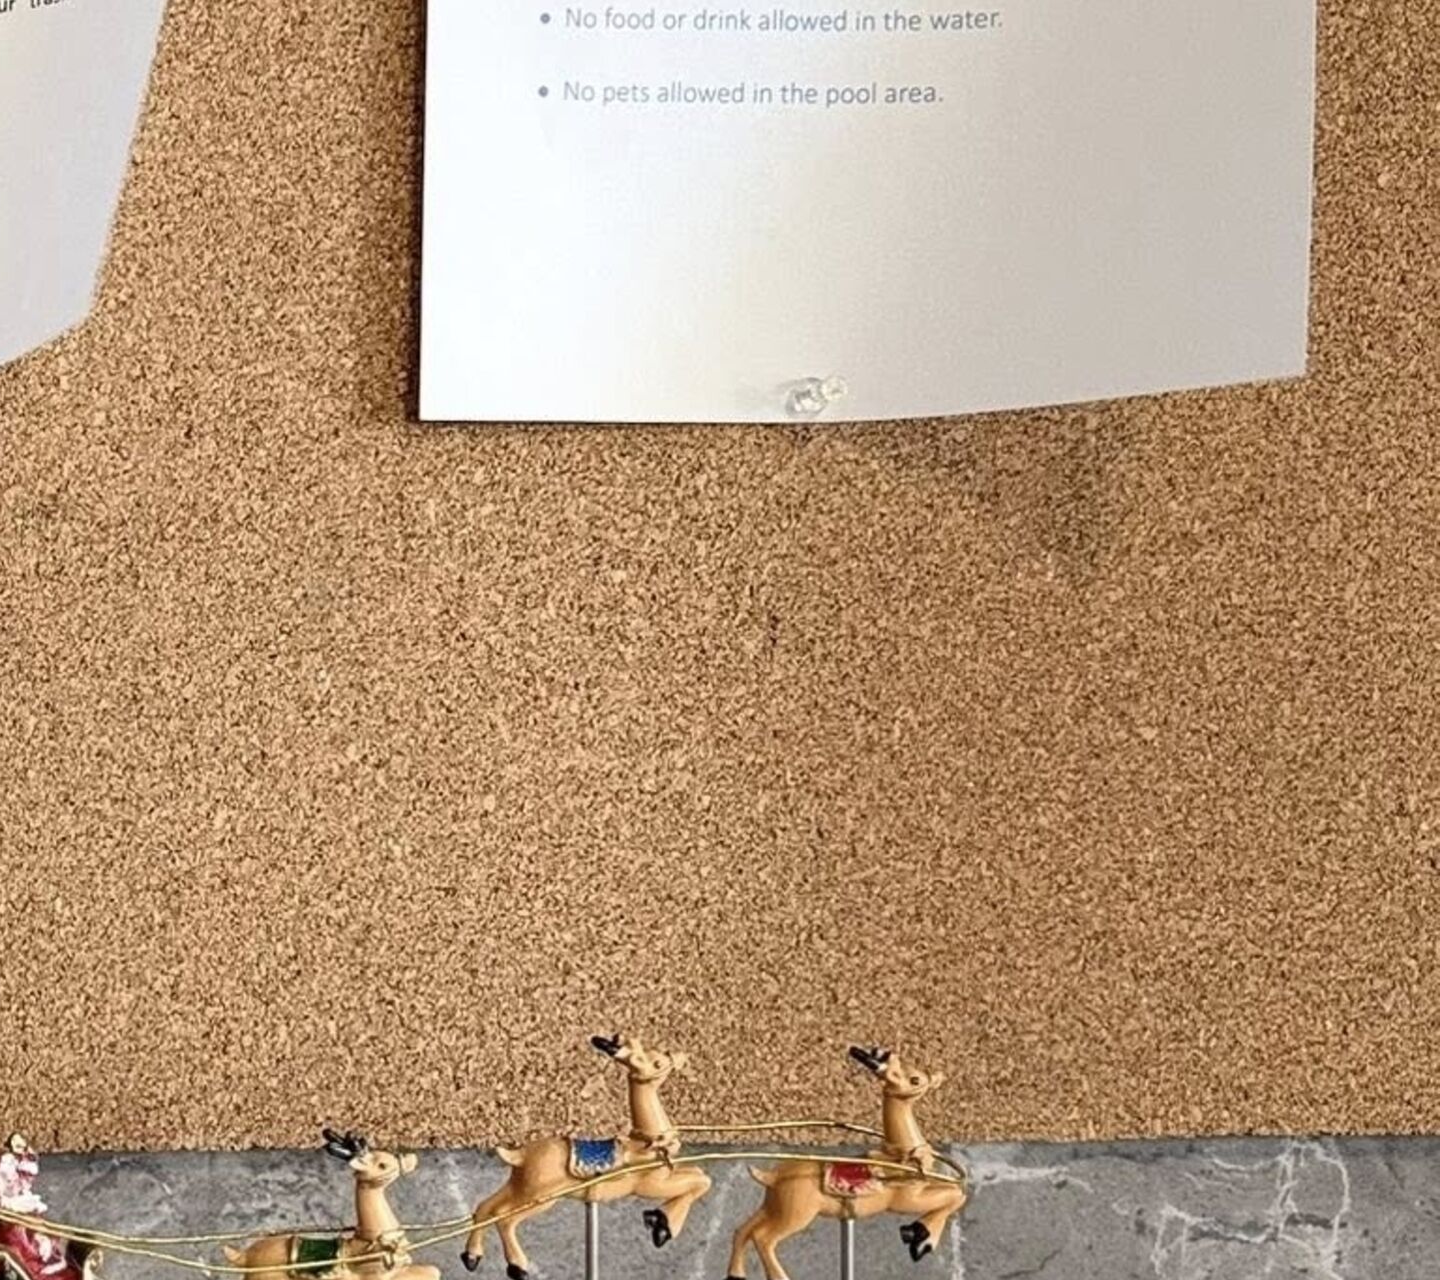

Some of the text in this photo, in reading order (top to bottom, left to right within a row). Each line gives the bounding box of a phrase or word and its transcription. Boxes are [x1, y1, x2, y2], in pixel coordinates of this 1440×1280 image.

[566, 6, 1003, 32] No food or drink allowed in the water.
[563, 81, 944, 109] No pets allowed in the pool area.
